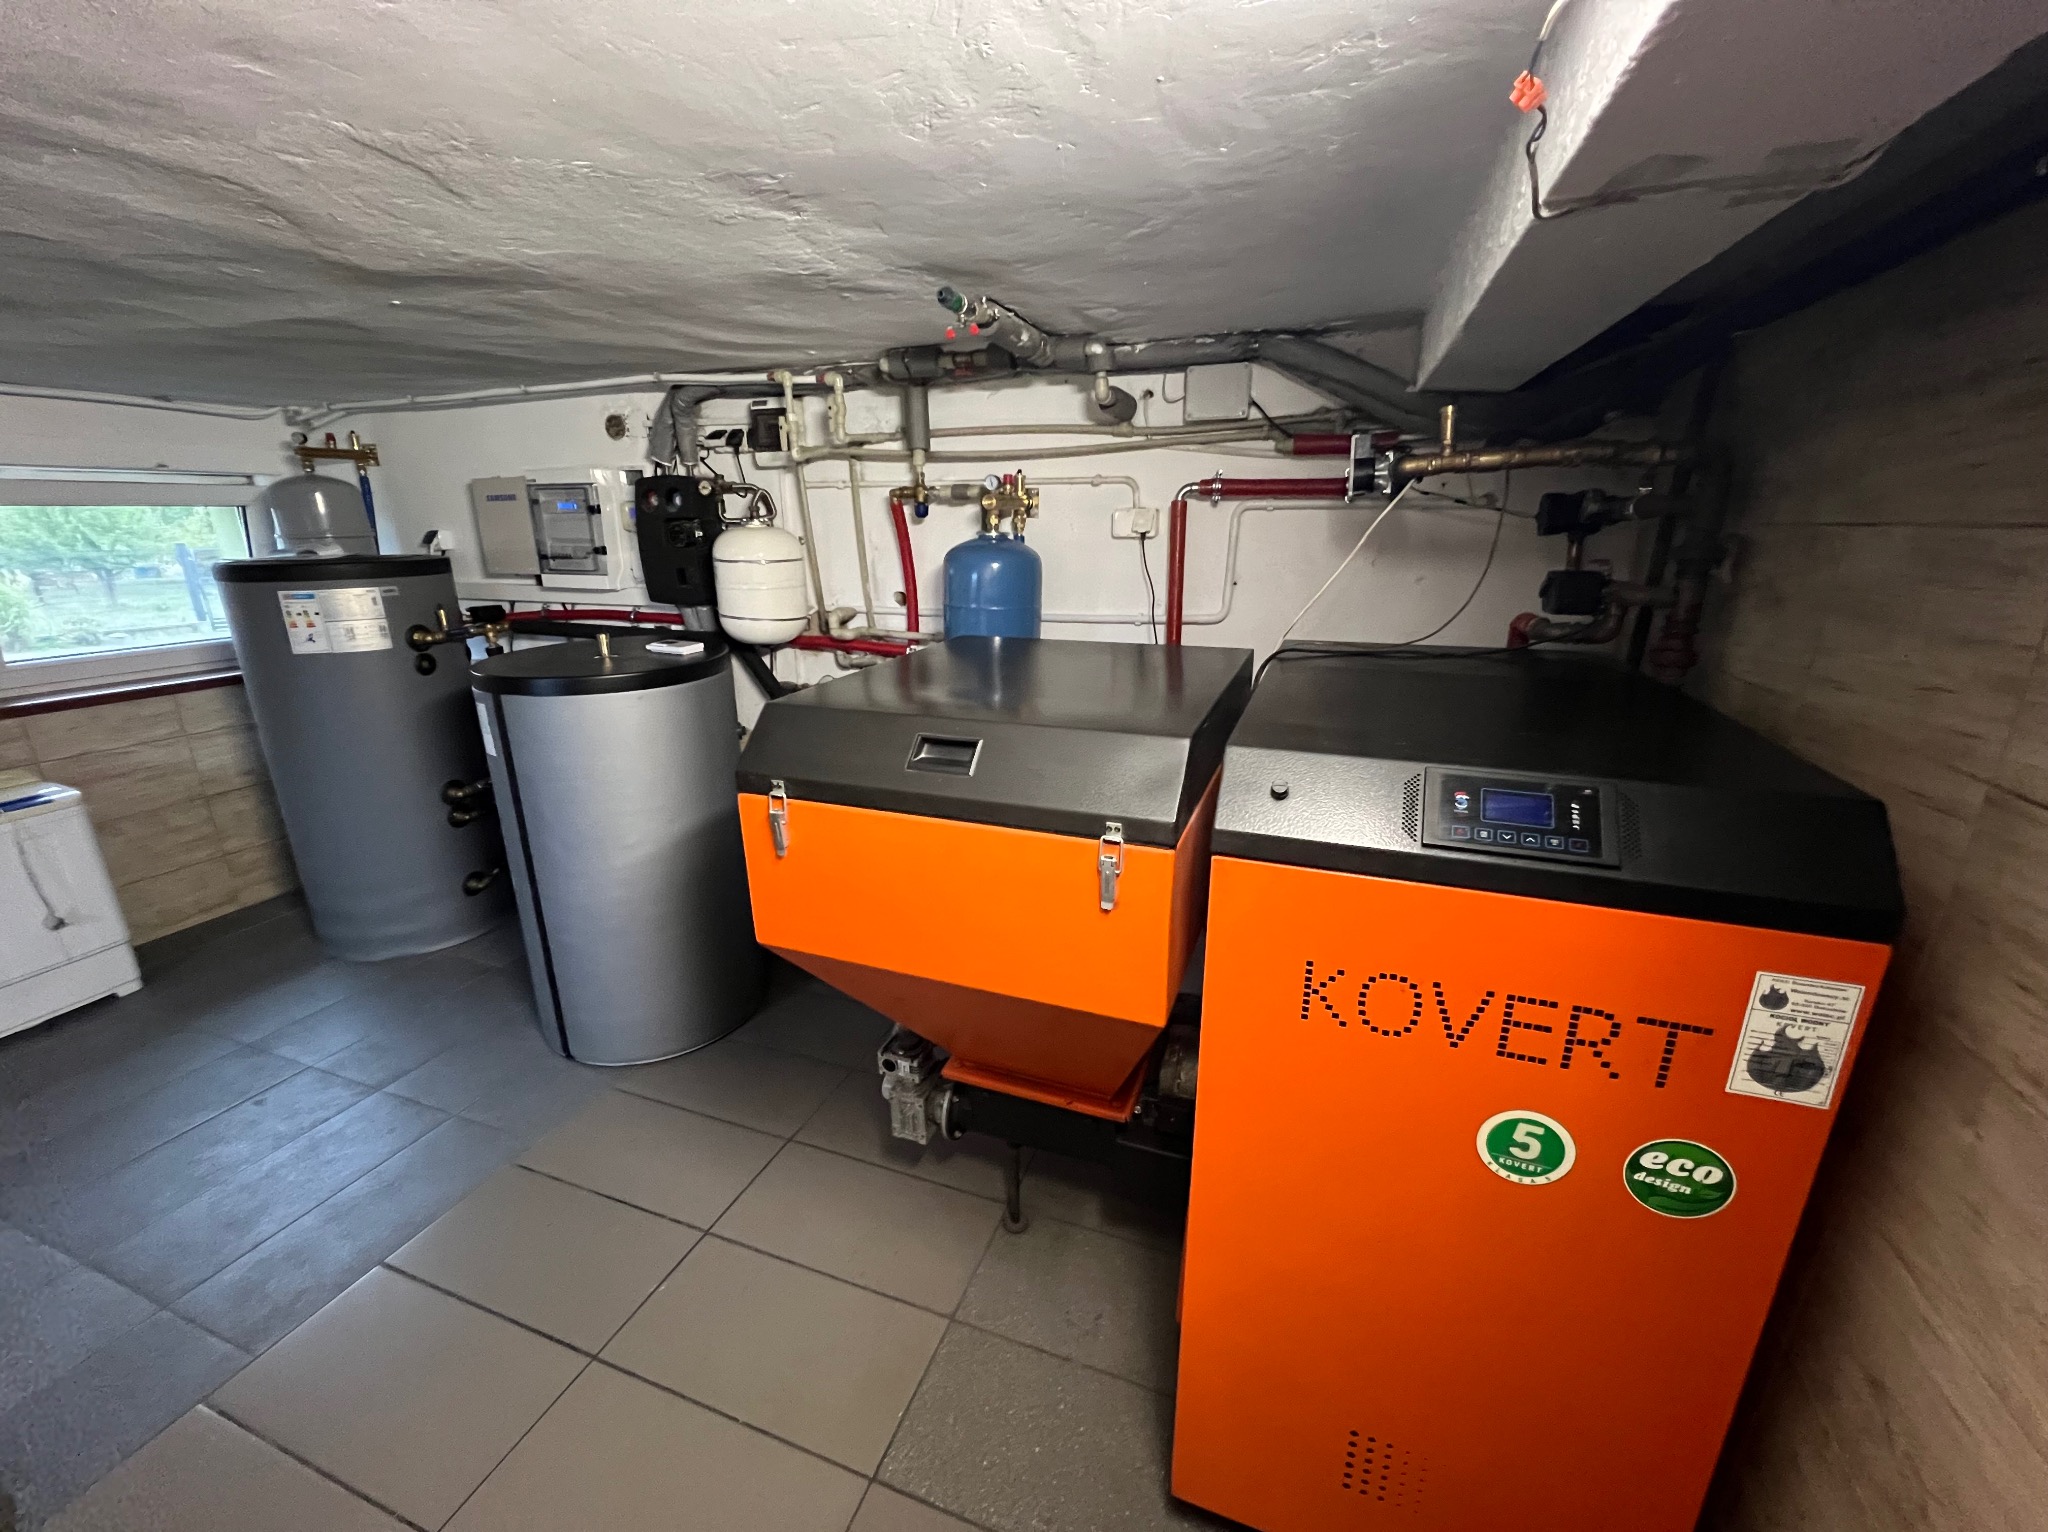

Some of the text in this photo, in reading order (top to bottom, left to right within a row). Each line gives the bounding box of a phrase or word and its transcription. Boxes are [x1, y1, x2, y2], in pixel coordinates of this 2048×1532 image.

[1301, 960, 1714, 1088] KOVERT
[1509, 1122, 1545, 1160] 5
[1487, 1161, 1536, 1184] KLASA
[1498, 1157, 1543, 1174] KOVERT
[1639, 1151, 1724, 1185] eco
[1633, 1171, 1692, 1195] design
